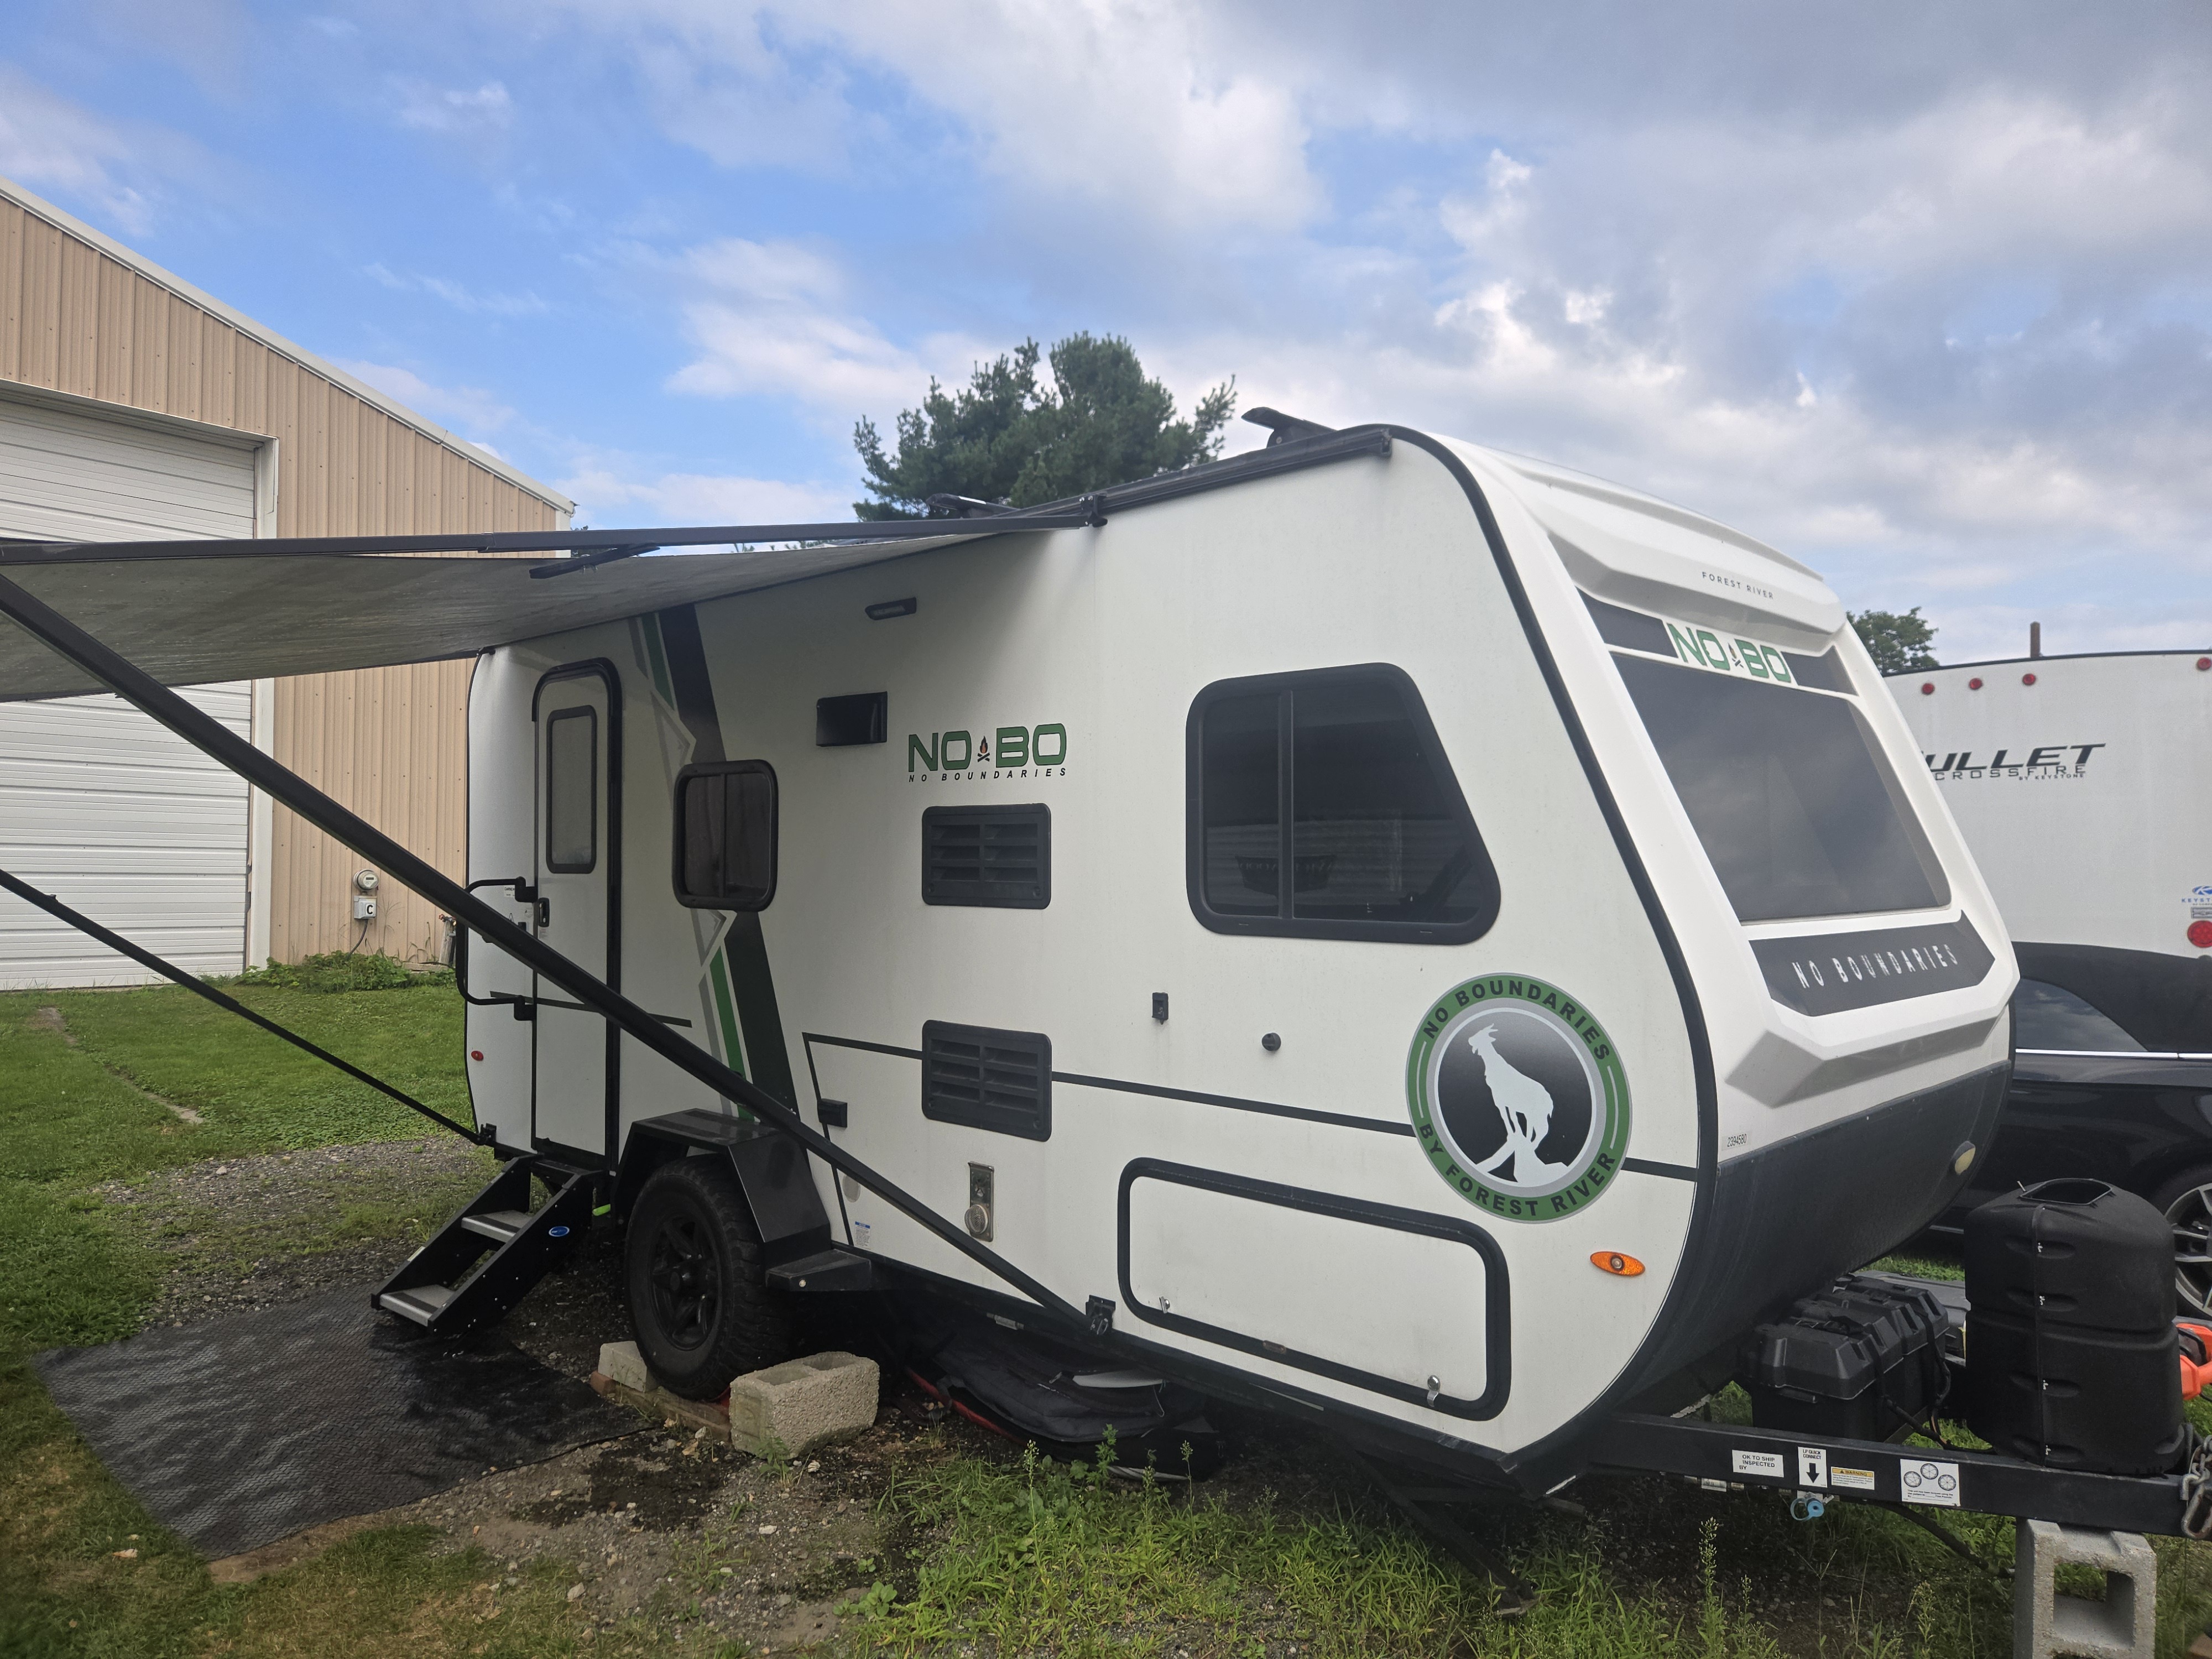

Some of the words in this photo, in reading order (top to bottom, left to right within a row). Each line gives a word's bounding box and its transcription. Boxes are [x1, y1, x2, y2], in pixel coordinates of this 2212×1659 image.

[1702, 571, 1741, 589] FOREST
[1746, 585, 1774, 600] RIVER
[1921, 743, 2106, 772] ULLET
[909, 774, 927, 782] NO
[941, 768, 1066, 781] BOUNDARIES
[1934, 764, 2086, 781] CROSSFIRE
[366, 904, 373, 915] C
[1792, 960, 1824, 989] NO
[1832, 944, 1958, 983] BOUNDARIES
[1423, 1008, 1448, 1039] NO
[1454, 980, 1610, 1060] BOUNDARIES
[1419, 1123, 1444, 1154] BY
[1446, 1164, 1538, 1216] FOREST
[1551, 1152, 1616, 1212] RIVER
